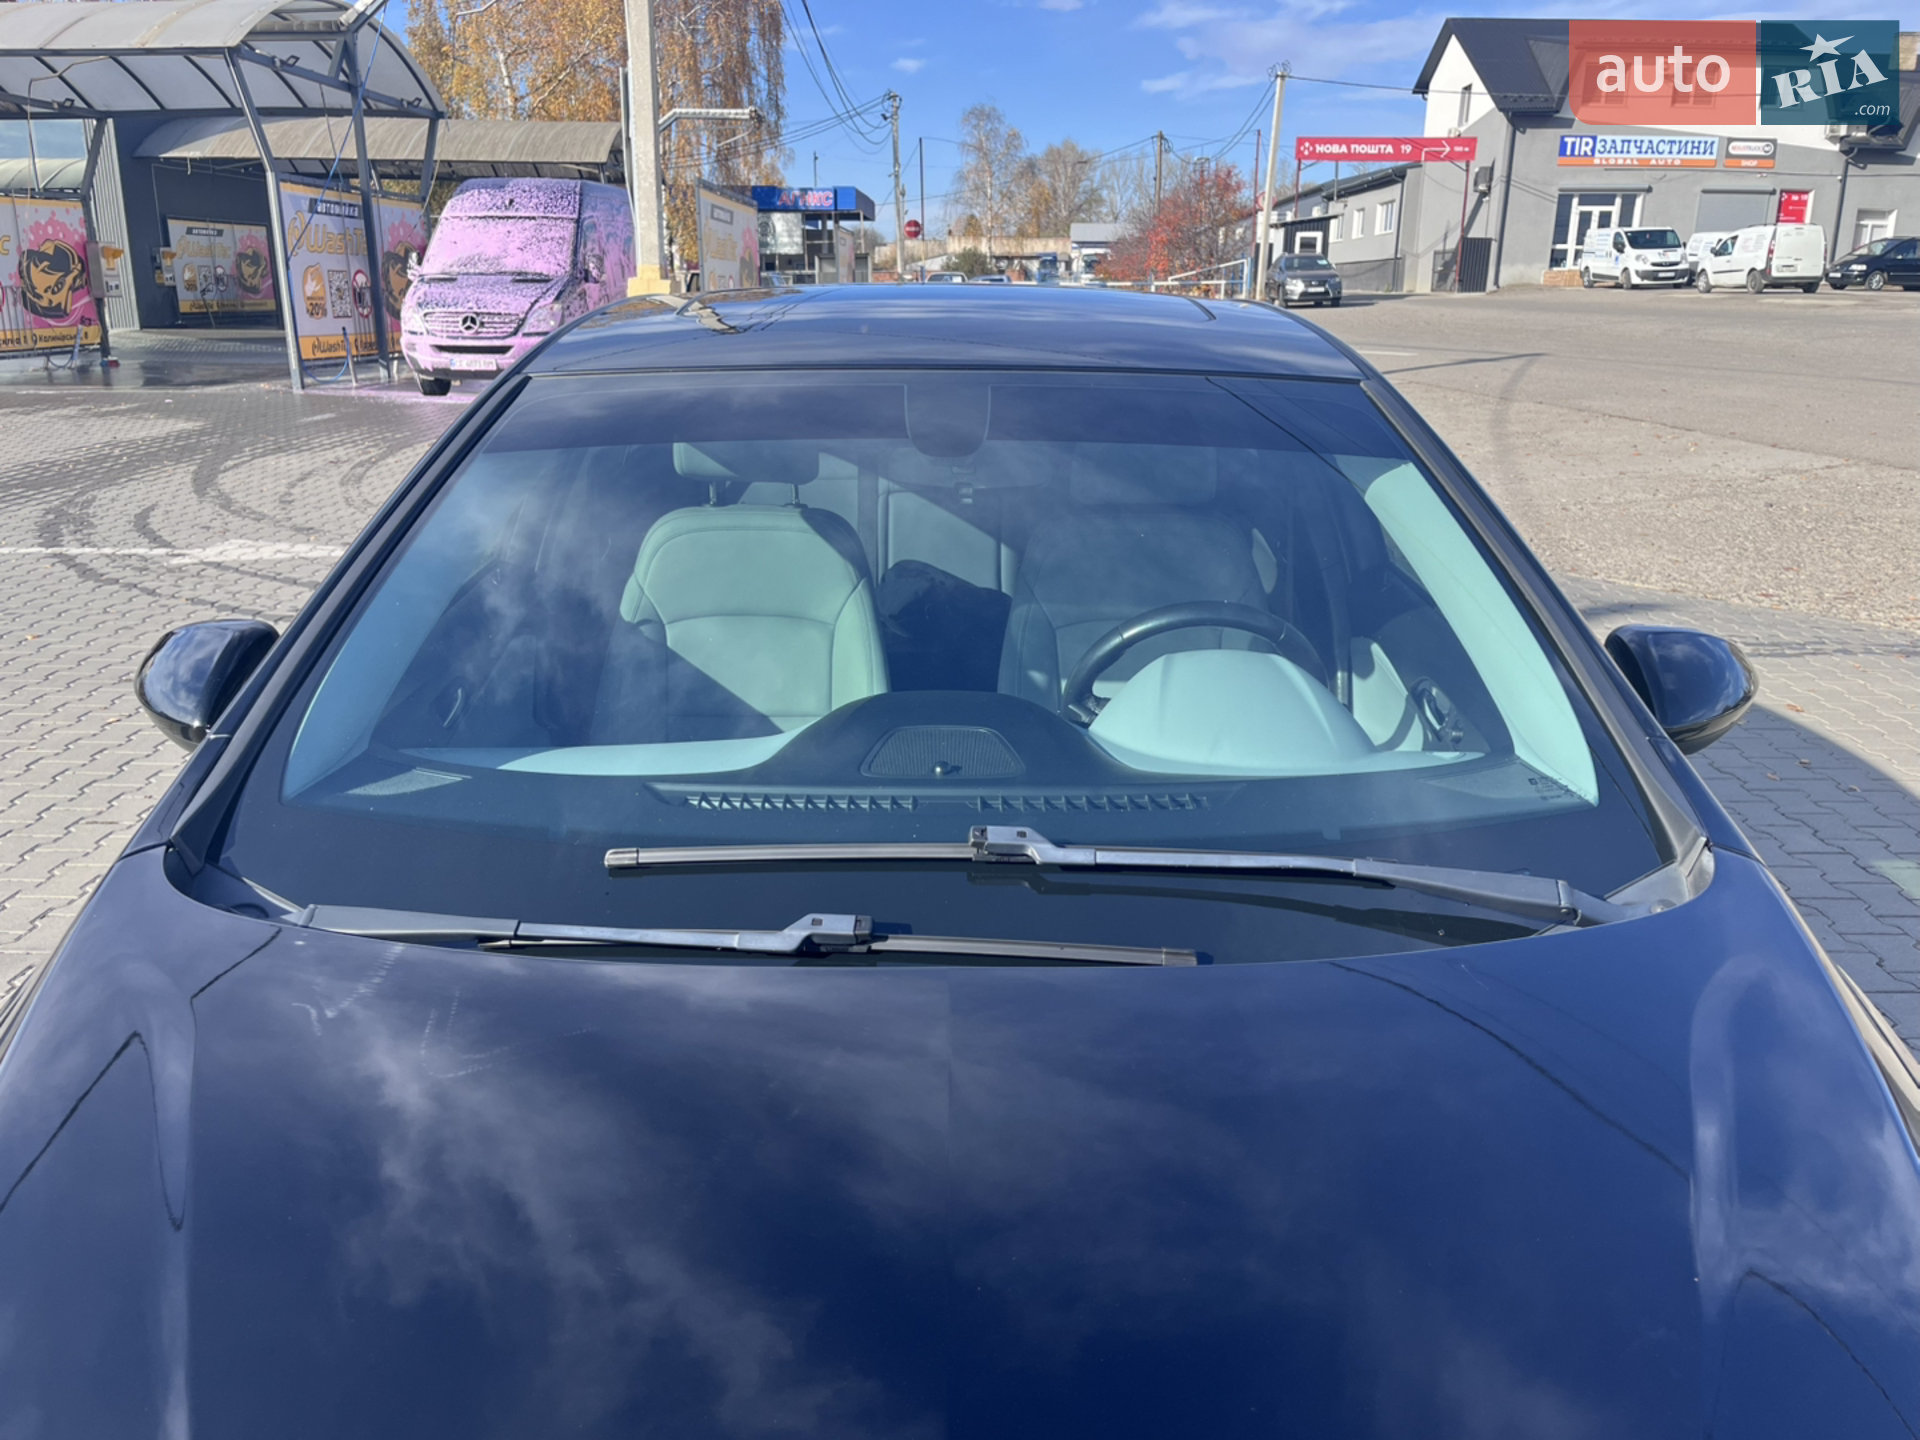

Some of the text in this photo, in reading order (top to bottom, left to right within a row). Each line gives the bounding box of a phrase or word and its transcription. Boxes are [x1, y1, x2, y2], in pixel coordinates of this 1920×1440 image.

[1315, 144, 1348, 154] НОВА
[1350, 144, 1394, 155] ПОШТА
[1400, 144, 1412, 154] 19
[1563, 137, 1716, 156] TIR ЗАПЧАСТИНИ
[1649, 158, 1682, 166] AUTO
[778, 190, 834, 207] АГНКС
